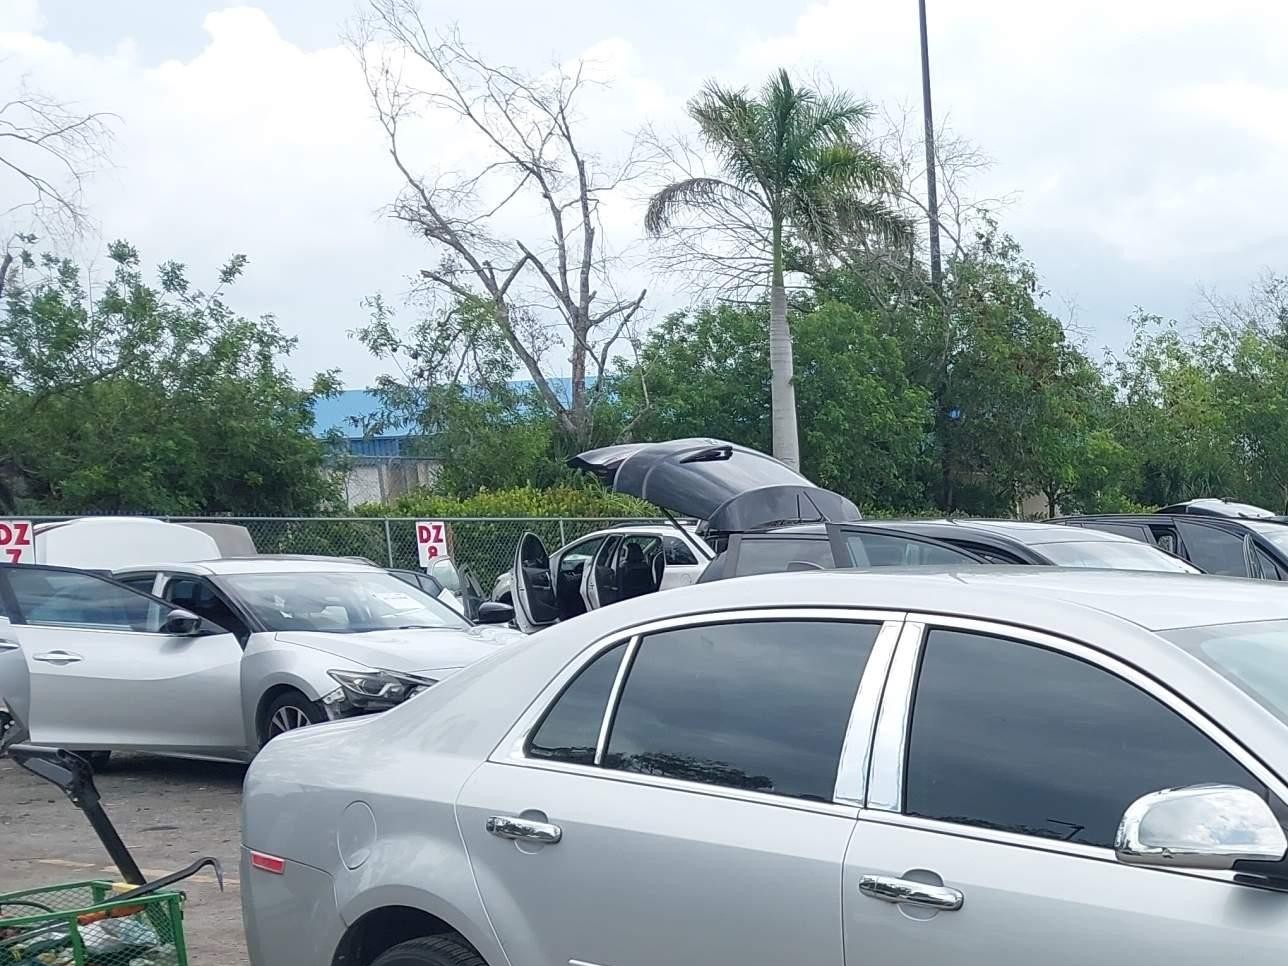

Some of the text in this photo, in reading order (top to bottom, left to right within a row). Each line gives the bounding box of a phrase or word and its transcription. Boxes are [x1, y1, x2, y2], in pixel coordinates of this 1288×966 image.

[0, 524, 30, 545] DZ
[418, 525, 443, 543] DZ
[6, 549, 22, 564] 7
